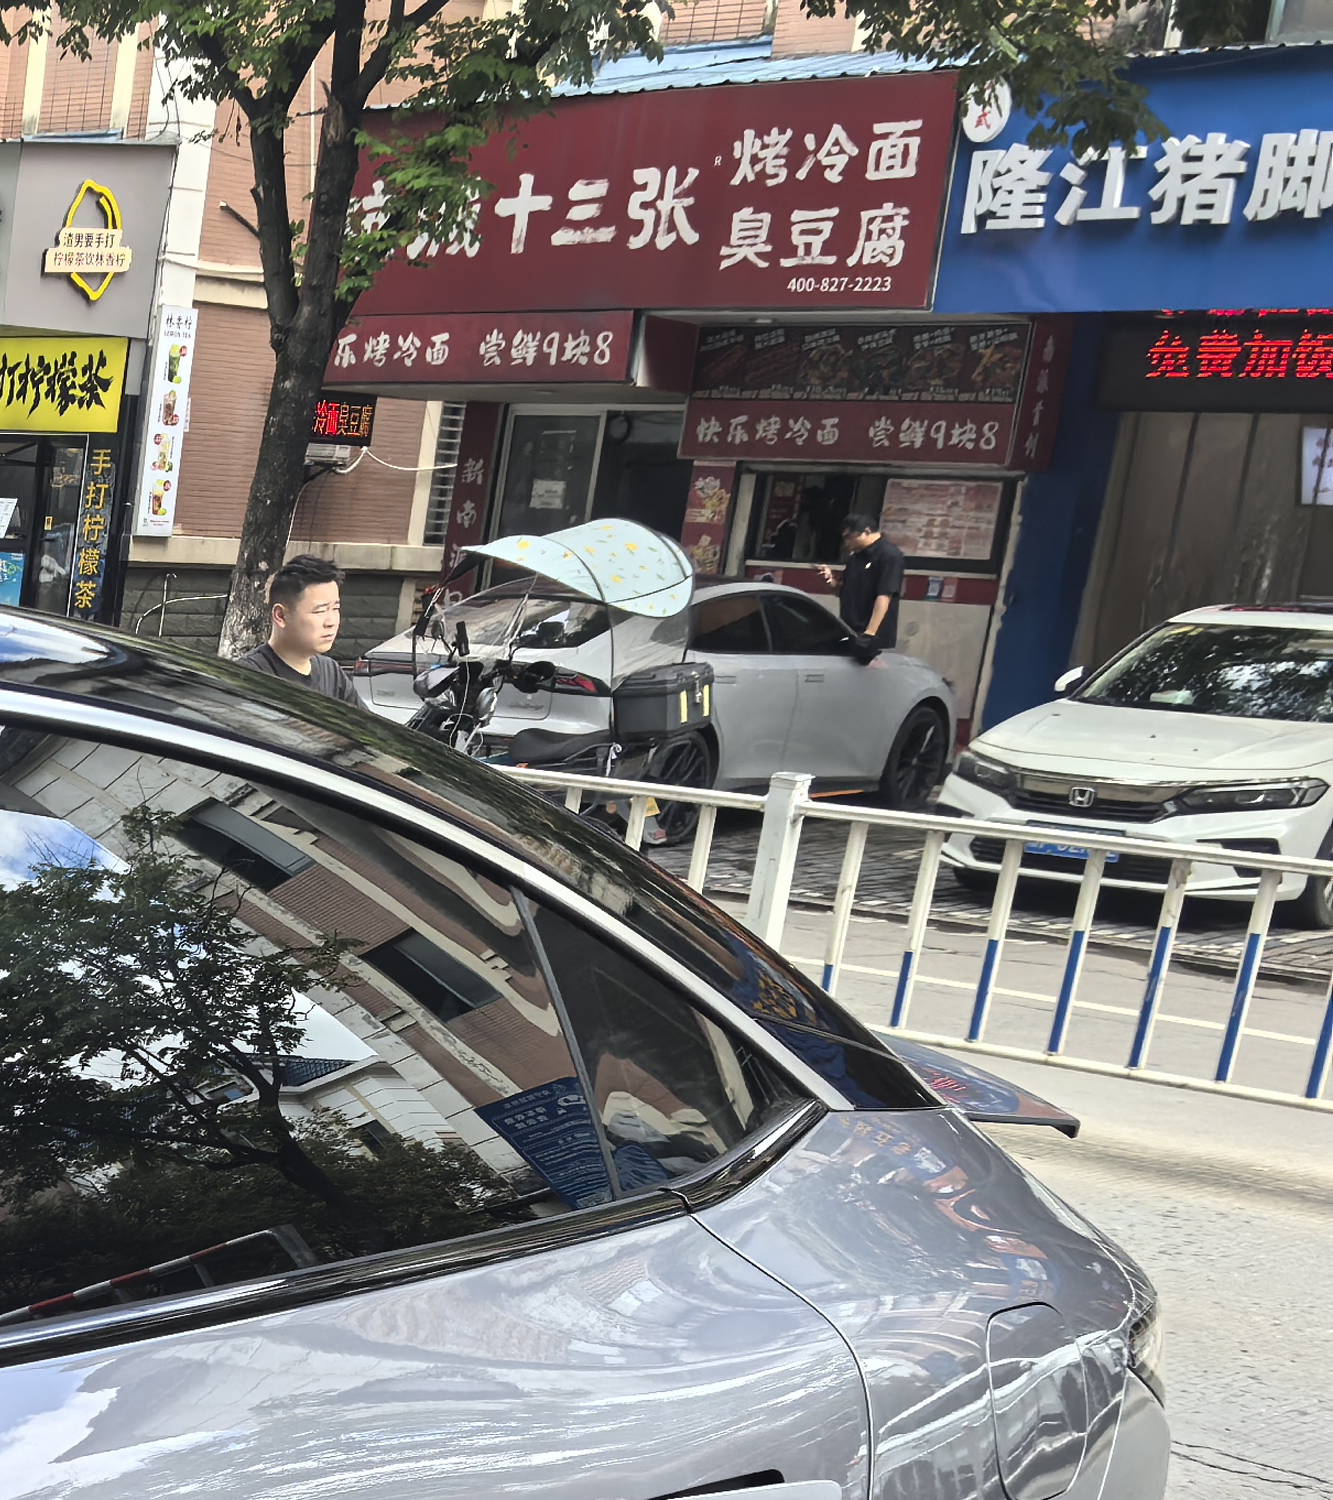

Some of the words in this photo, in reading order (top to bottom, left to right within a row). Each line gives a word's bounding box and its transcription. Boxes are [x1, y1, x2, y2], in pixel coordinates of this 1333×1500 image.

[733, 119, 923, 188] 烤冷面
[960, 129, 1333, 235] 隆江猪脚
[63, 232, 116, 249] 渣男要手打
[719, 203, 910, 271] 臭豆腐
[53, 251, 126, 268] 柠檬茶饮林香柠
[786, 275, 892, 293] 400-827-2223
[334, 331, 451, 367] 乐烤冷面
[479, 328, 614, 367] 尝鲜9块8
[696, 415, 840, 446] 快乐烤冷面
[868, 416, 1000, 450] 尝鲜9块8
[74, 449, 112, 609] 手打柠檬茶
